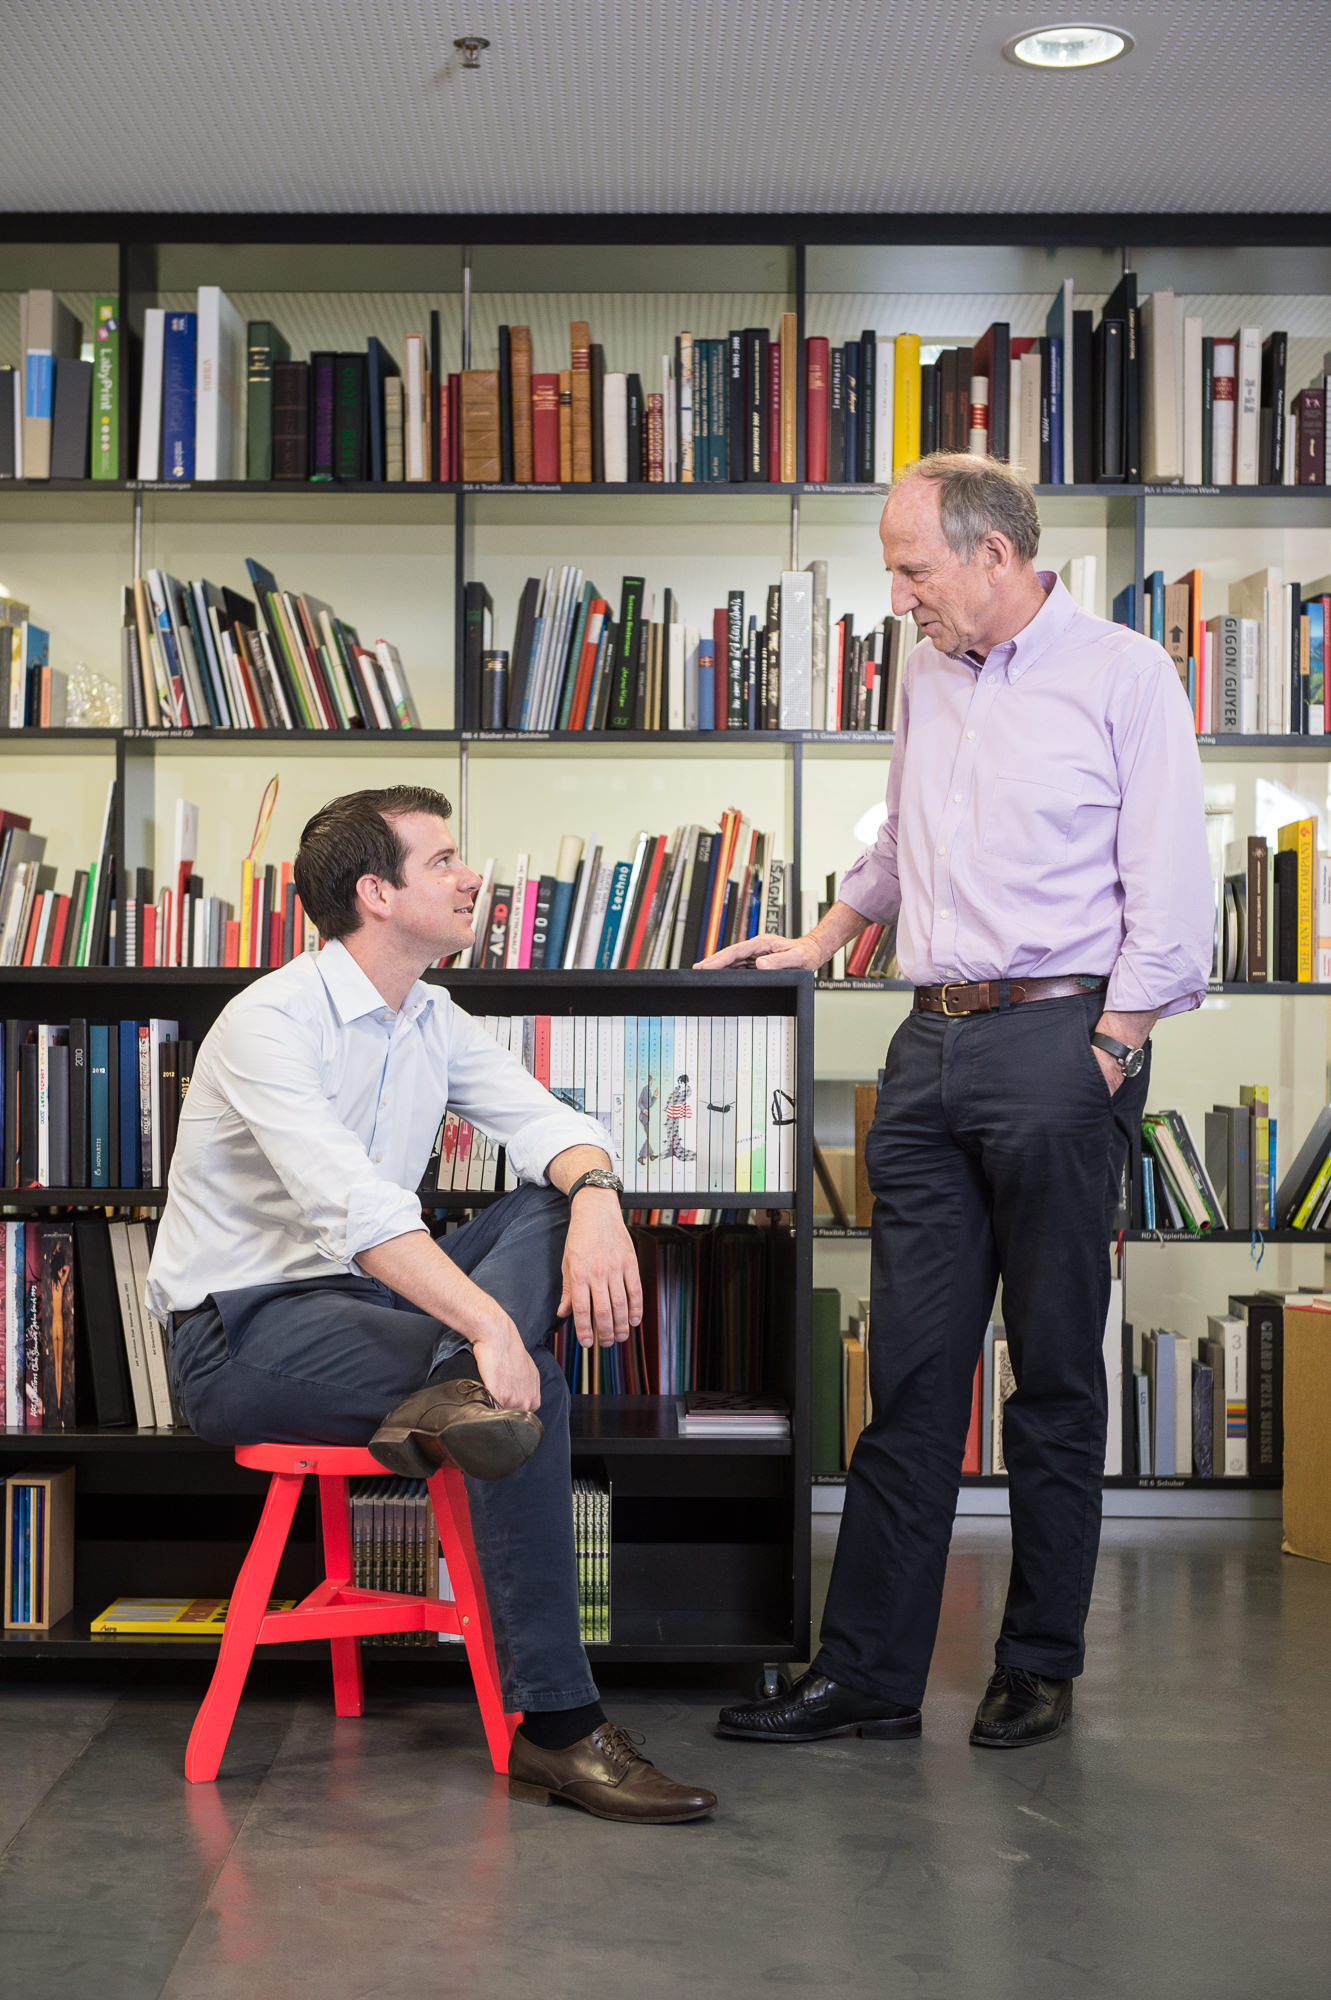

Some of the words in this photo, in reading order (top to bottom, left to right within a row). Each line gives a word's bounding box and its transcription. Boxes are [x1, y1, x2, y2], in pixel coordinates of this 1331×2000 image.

[97, 348, 112, 410] LabyPrint
[1224, 617, 1237, 727] GIGON/GUYER
[1299, 840, 1310, 893] COMPANY
[611, 866, 630, 911] techno
[765, 865, 781, 934] SAGMEIS
[1300, 898, 1310, 924] TREE
[1300, 950, 1310, 972] THE
[819, 981, 842, 990] Originelle
[75, 1048, 83, 1066] 2010
[1141, 1231, 1152, 1239] RD
[1231, 1335, 1242, 1350] 3
[1260, 1320, 1273, 1371] GRAND
[1260, 1373, 1273, 1408] PRIX
[1260, 1411, 1273, 1465] SUISSE
[817, 1475, 846, 1483] Schuber
[1139, 1479, 1150, 1487] RE
[1156, 1479, 1185, 1487] Schuber
